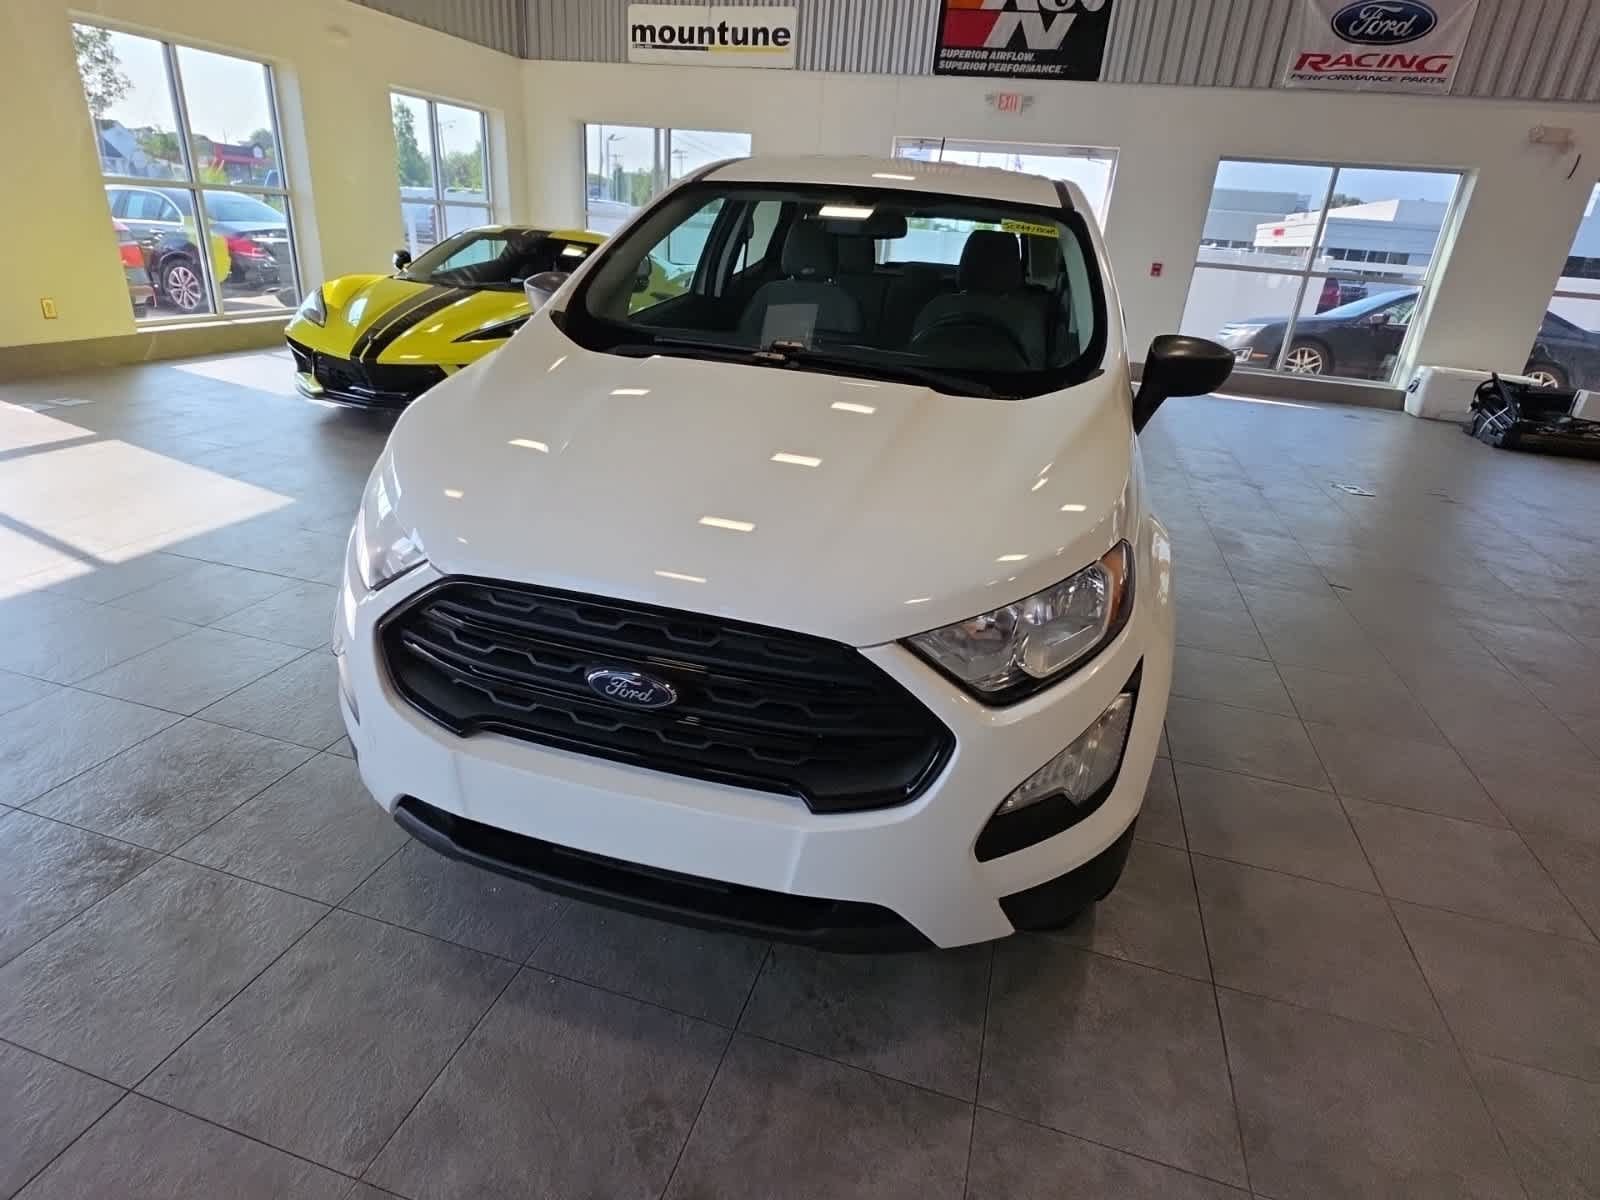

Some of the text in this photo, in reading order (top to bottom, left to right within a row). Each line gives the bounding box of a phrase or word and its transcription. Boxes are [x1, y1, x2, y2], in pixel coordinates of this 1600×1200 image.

[1350, 4, 1418, 37] Ford
[631, 20, 791, 46] mountune
[940, 48, 988, 60] SUPERIOR
[1294, 53, 1454, 74] RACING
[938, 60, 986, 71] SUPERIOR
[1290, 73, 1448, 84] PERFORMANCE PARTS
[998, 95, 1017, 112] EXIT
[605, 676, 655, 702] Ford
